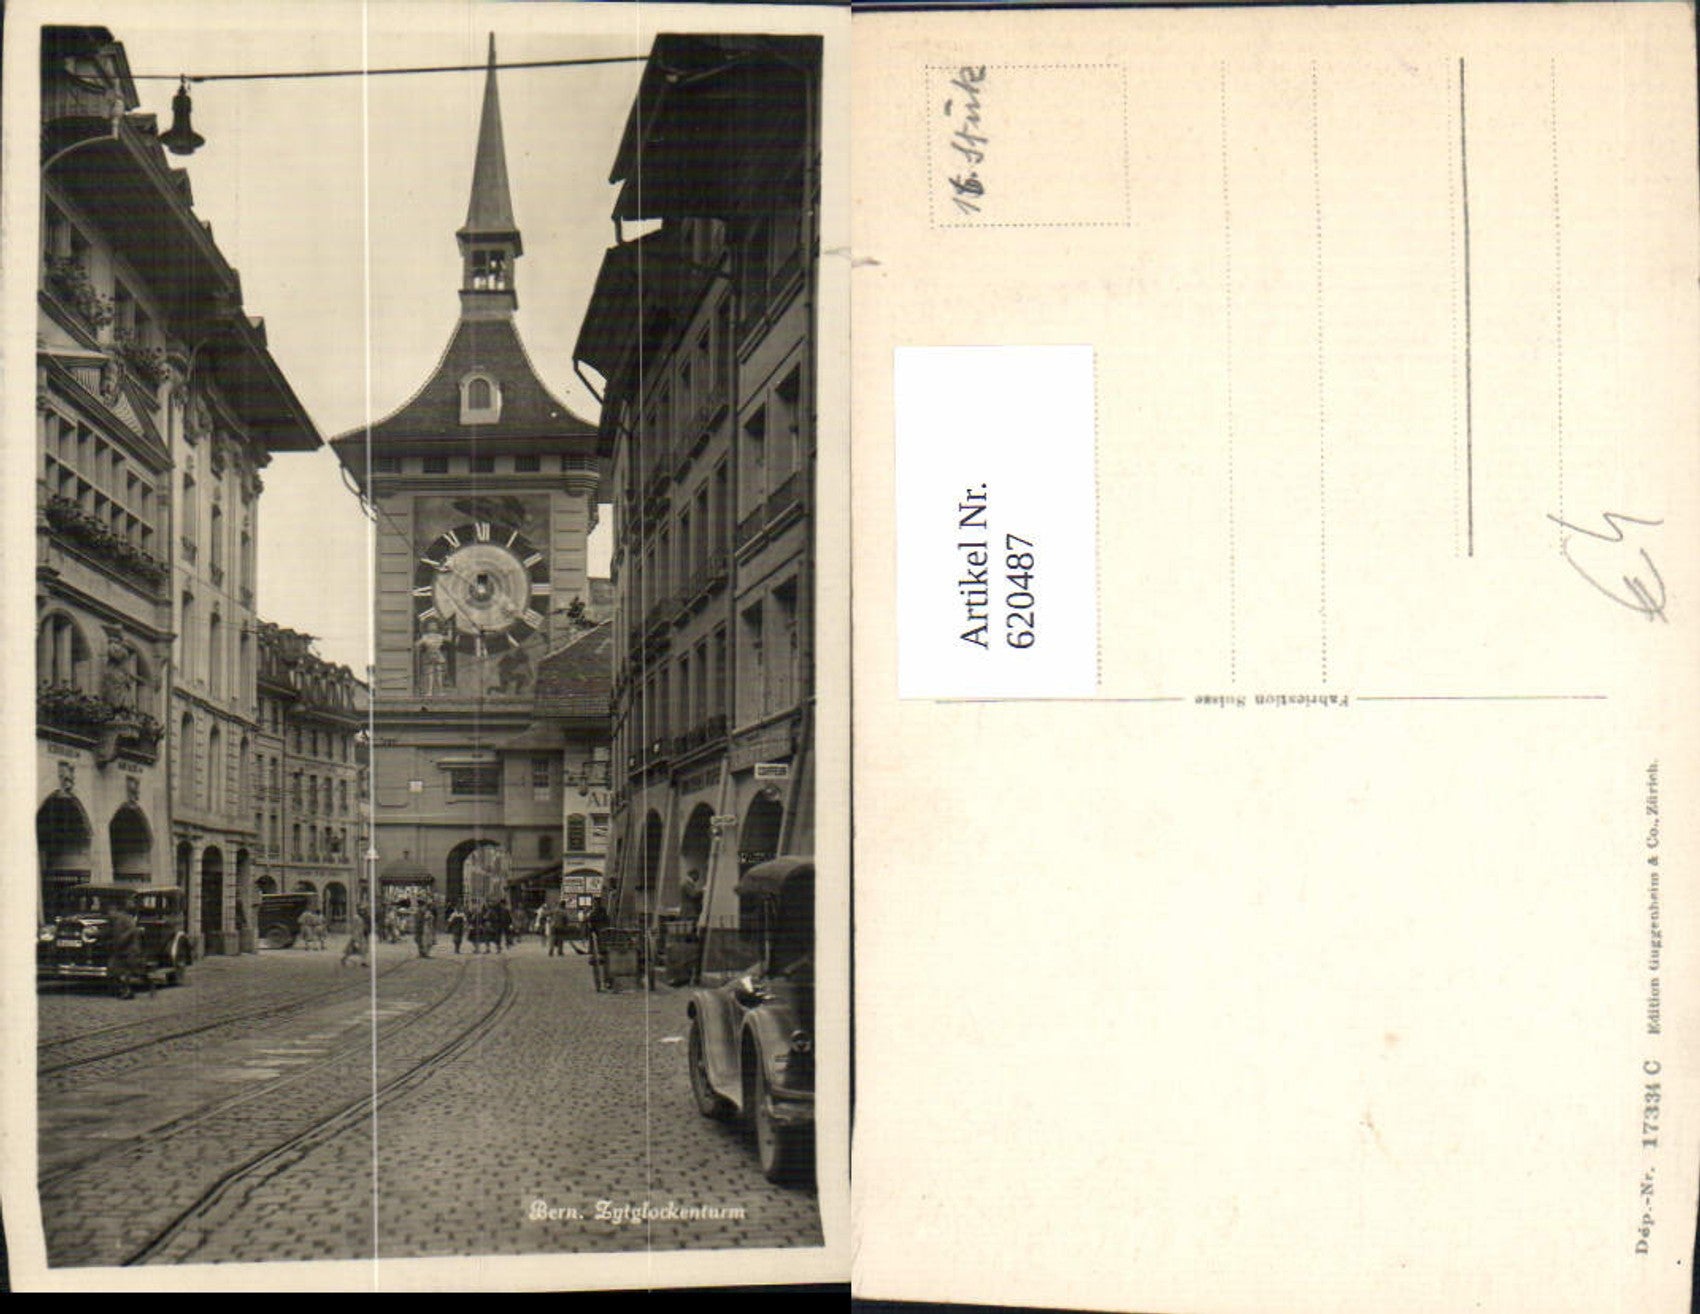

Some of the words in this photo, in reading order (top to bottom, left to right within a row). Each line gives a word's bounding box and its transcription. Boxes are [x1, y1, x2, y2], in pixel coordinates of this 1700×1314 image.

[957, 483, 987, 527] Nr.
[958, 542, 988, 649] Artikel
[1006, 533, 1035, 649] 620487
[1194, 695, 1246, 709] Suisse
[1648, 872, 1663, 971] Guggenheim
[1647, 977, 1661, 1035] Edition
